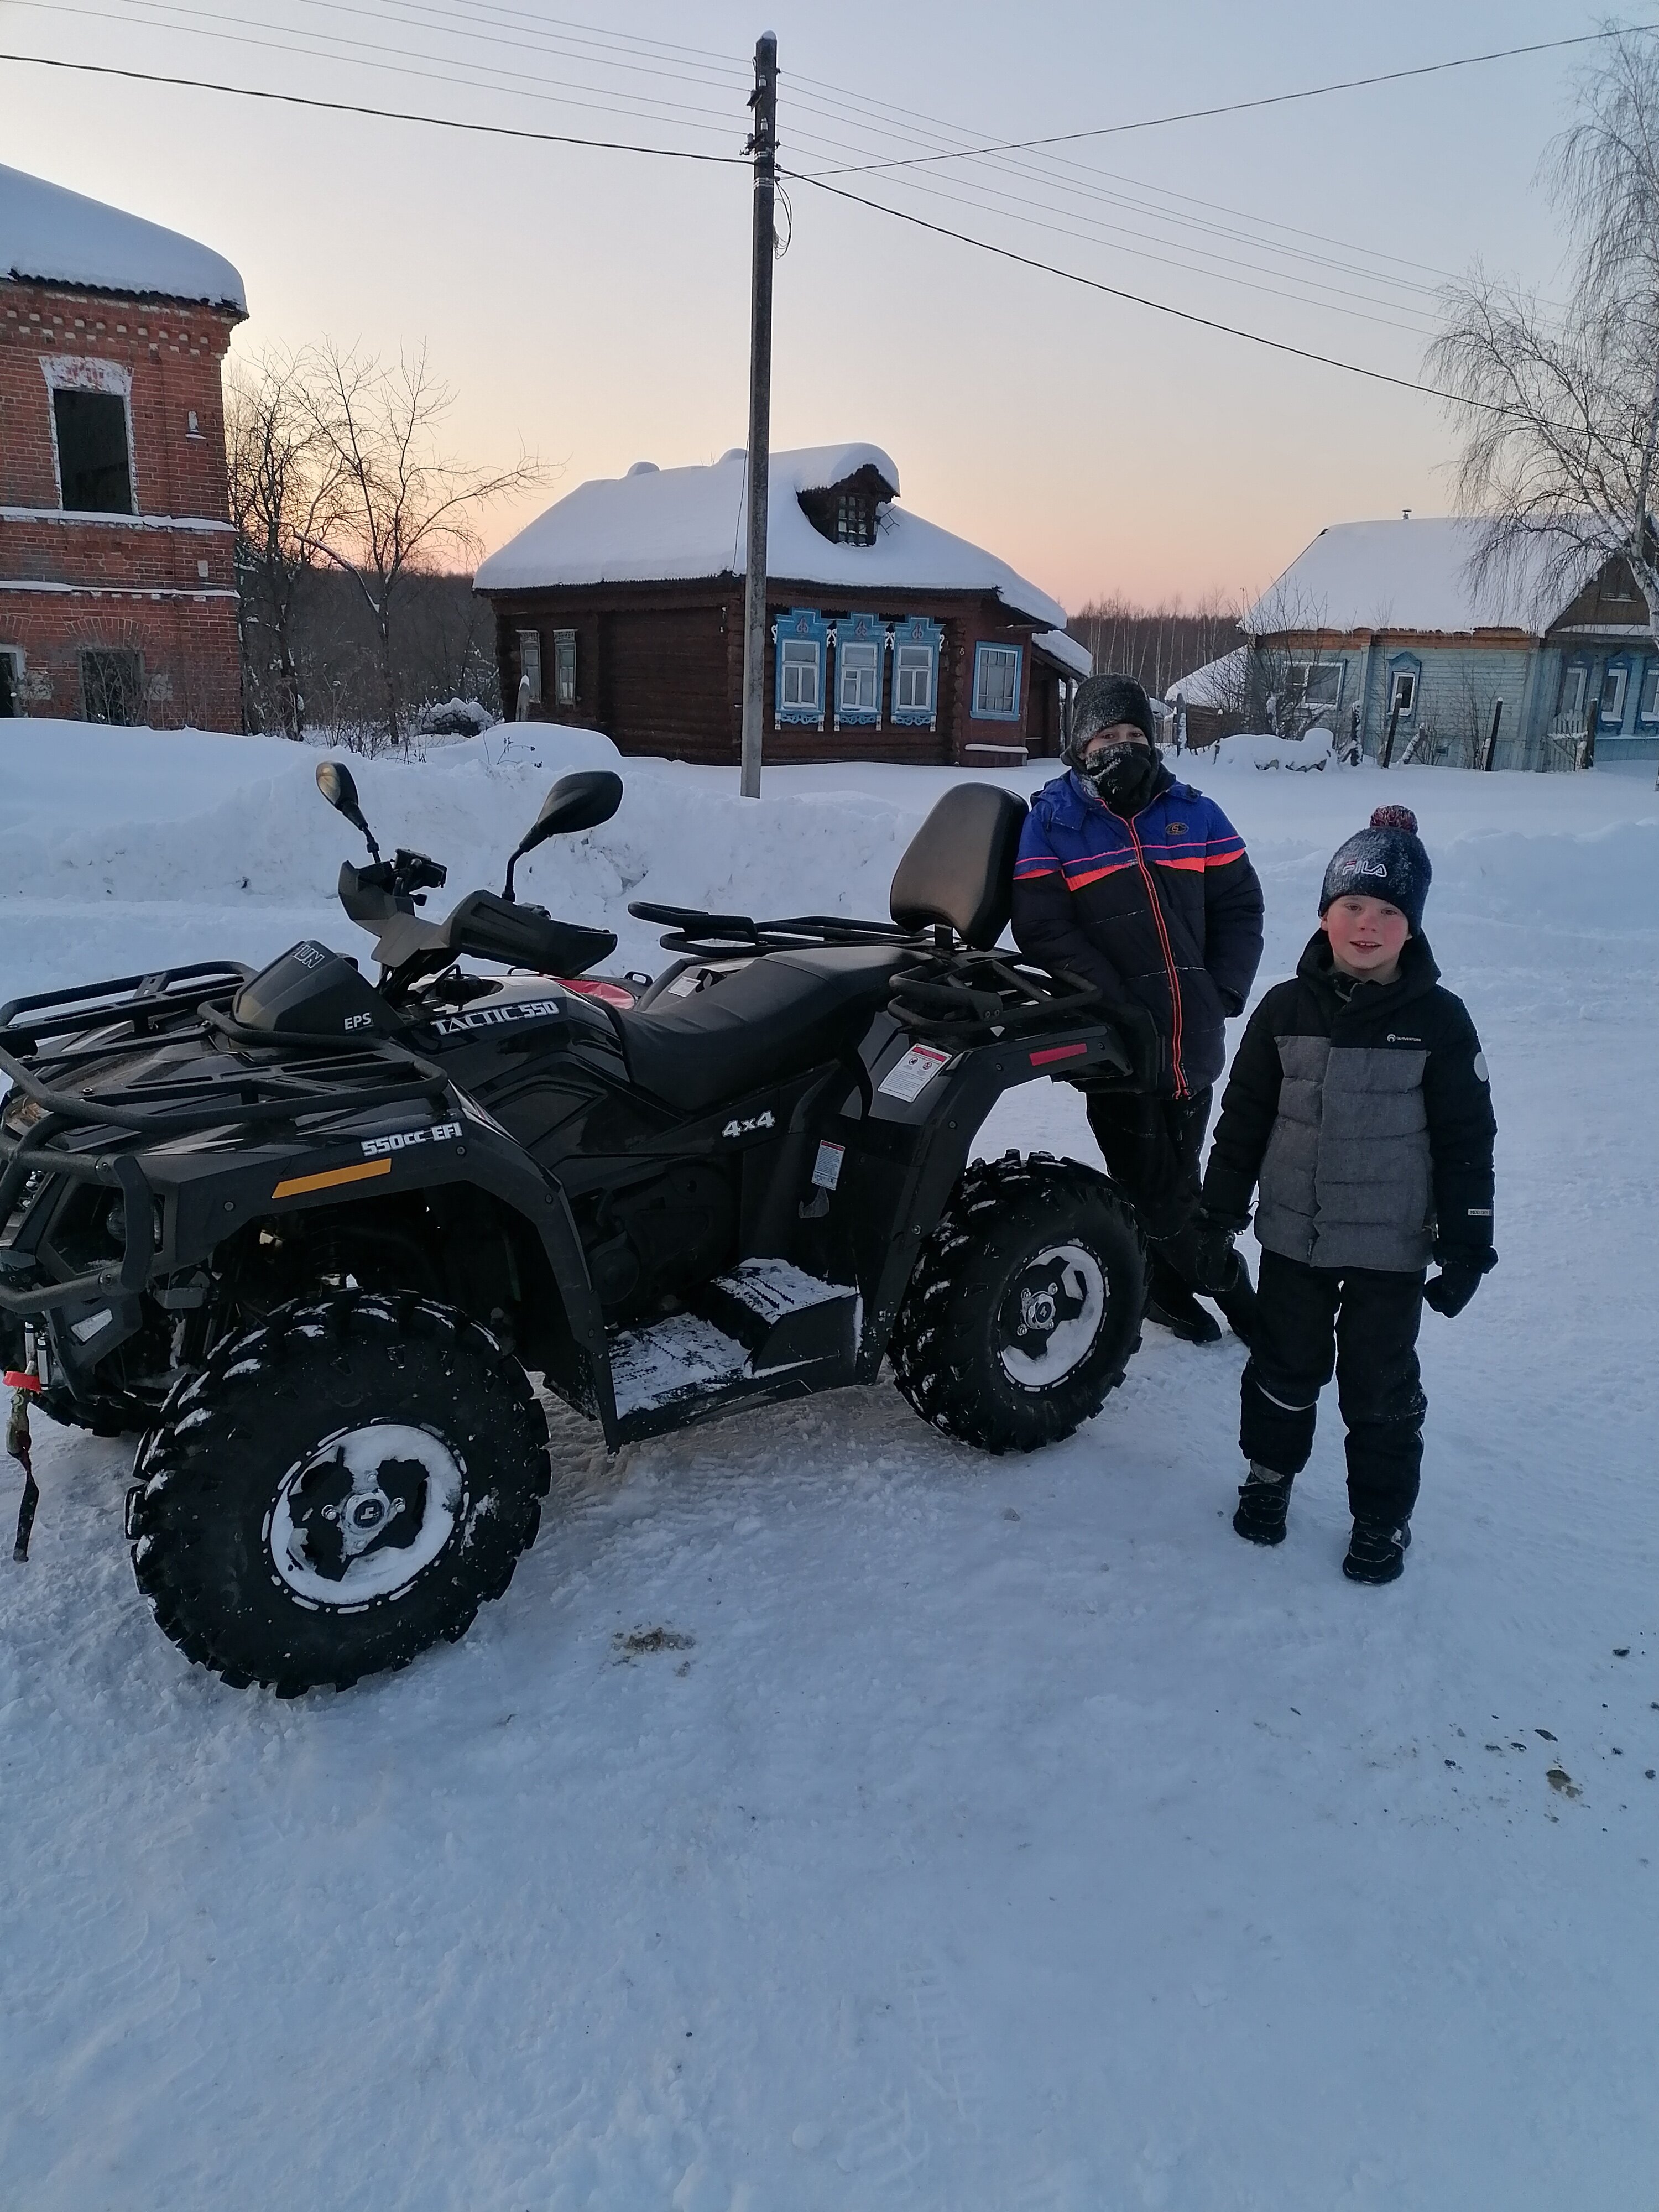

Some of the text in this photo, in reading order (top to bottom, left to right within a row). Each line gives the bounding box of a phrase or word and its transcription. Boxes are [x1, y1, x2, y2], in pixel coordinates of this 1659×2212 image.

[959, 647, 964, 655] 8
[1342, 860, 1387, 878] FILA
[345, 1012, 371, 1030] EPS
[430, 1001, 560, 1035] TACTIC 550
[722, 1110, 775, 1138] 4x4
[361, 1121, 463, 1157] 550cc EFI
